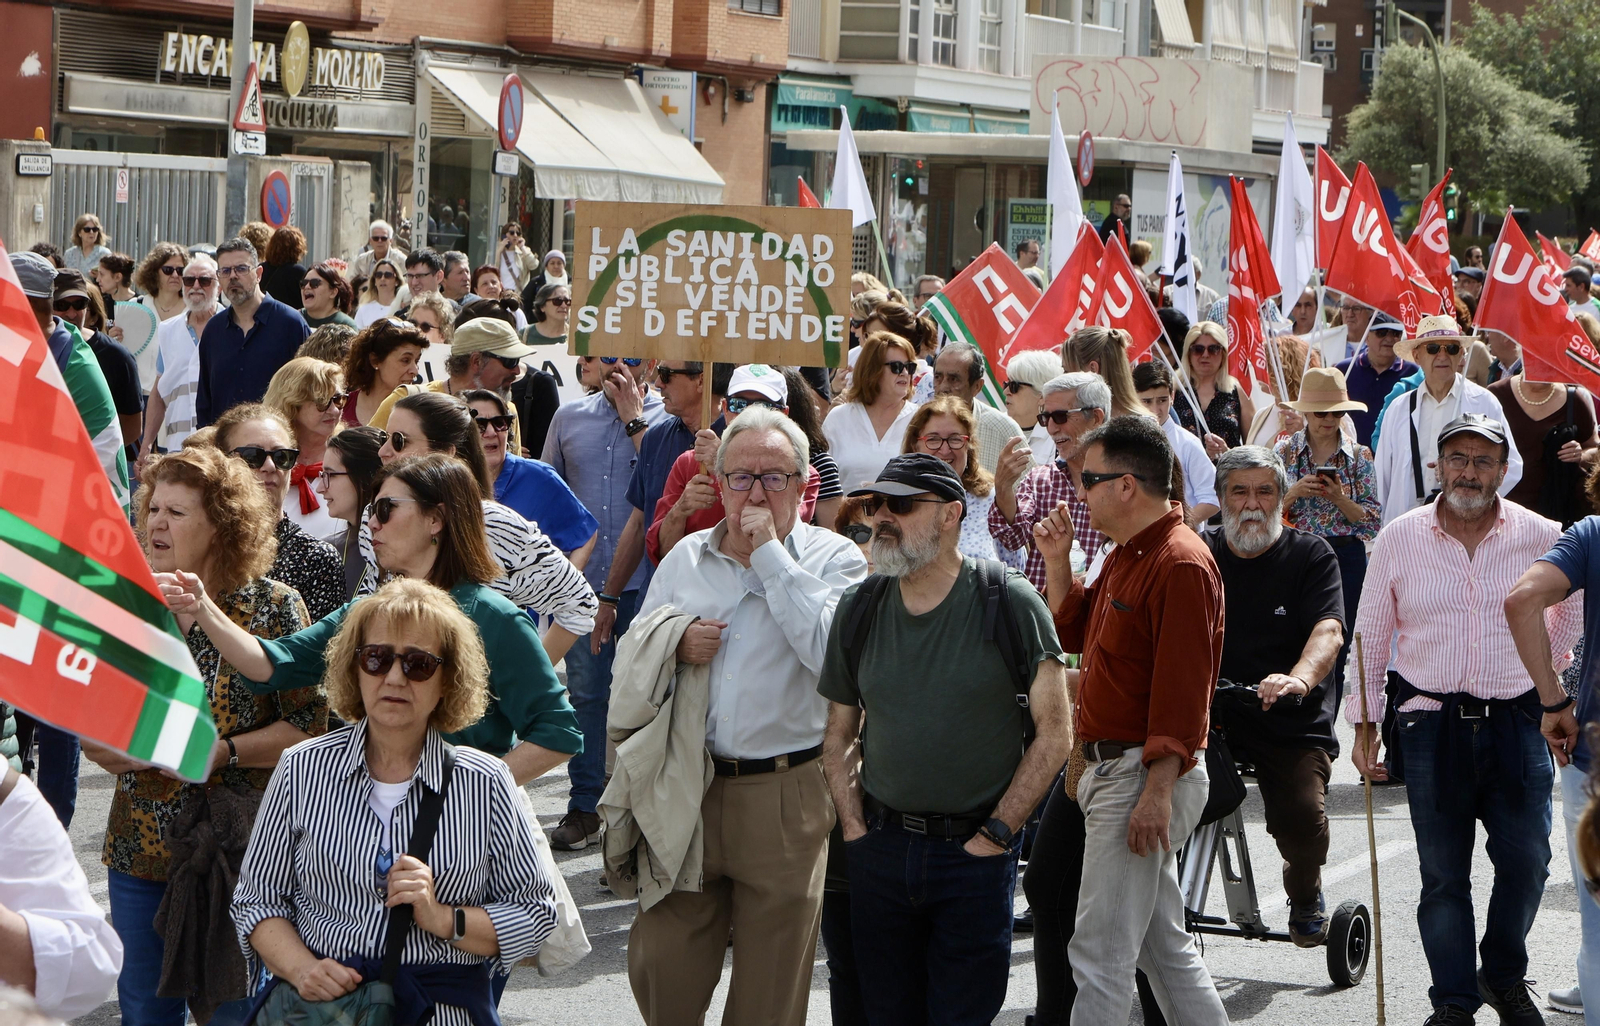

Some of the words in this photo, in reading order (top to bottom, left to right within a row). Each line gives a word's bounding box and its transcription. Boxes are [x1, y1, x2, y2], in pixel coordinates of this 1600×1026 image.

[162, 31, 277, 82] ENCANA
[314, 47, 386, 89] MORENO
[266, 100, 340, 129] UQUERIA
[1012, 214, 1025, 222] EL
[1137, 214, 1149, 233] TUS
[592, 227, 640, 255] LA
[665, 229, 834, 261] SANIDAD
[588, 255, 759, 285] PUBLICA
[785, 261, 835, 287] NO
[1493, 242, 1570, 314] UG
[616, 281, 658, 309] SE
[684, 285, 805, 313] VENDE
[577, 305, 622, 334] SE
